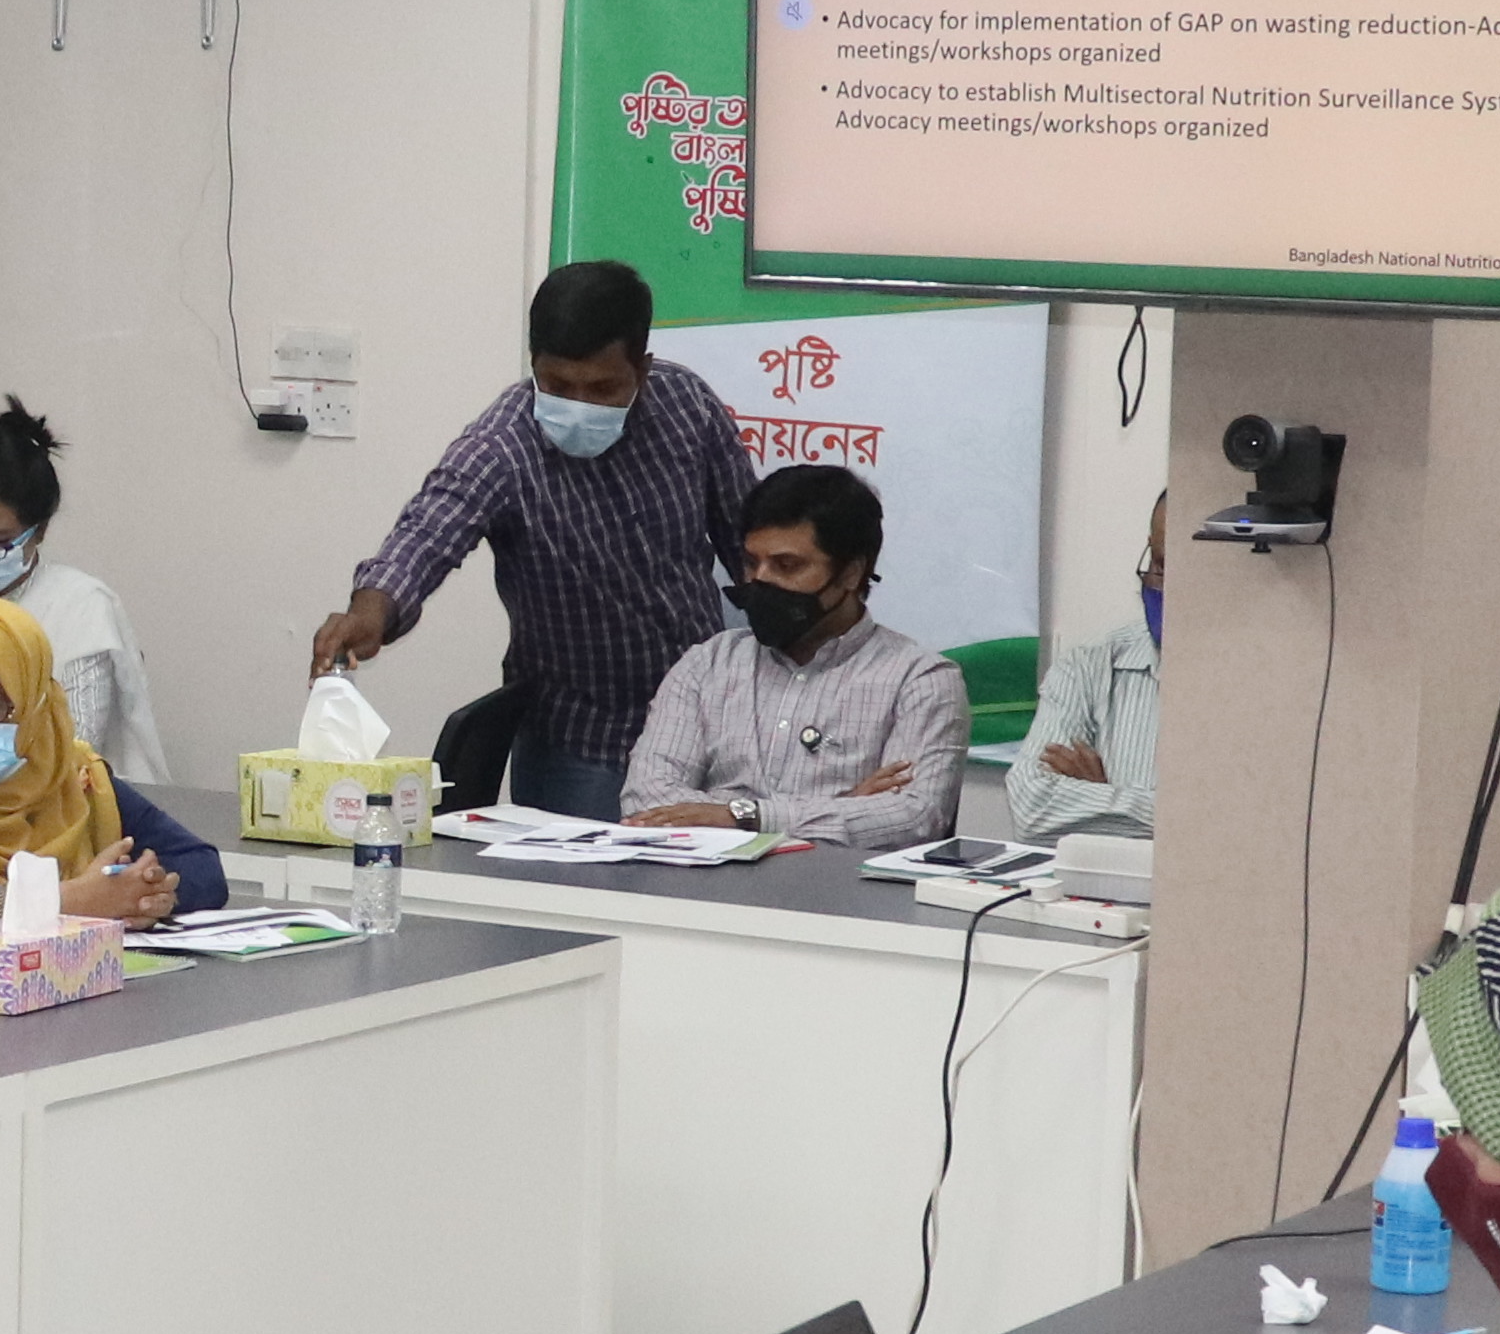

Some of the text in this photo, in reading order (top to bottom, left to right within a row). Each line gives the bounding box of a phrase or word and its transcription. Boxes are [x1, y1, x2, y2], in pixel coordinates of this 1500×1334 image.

[836, 9, 934, 34] Advocacy
[938, 10, 969, 29] for
[975, 11, 1143, 34] implementation
[1149, 12, 1173, 31] of
[1177, 13, 1224, 32] GAP
[1230, 18, 1258, 32] on
[1265, 14, 1351, 39] wasting
[837, 39, 1161, 66] meetings/workshops organized
[623, 74, 710, 136] পুষ্টির
[835, 79, 933, 104] Advocacy
[937, 84, 959, 100] to
[965, 82, 1056, 102] establish
[1064, 83, 1204, 105] Multisectoral
[1212, 87, 1311, 107] Nutrition
[1318, 88, 1455, 110] Surveillance
[835, 109, 1269, 140] Advocacy meetings/workshops organized
[1288, 248, 1374, 265] Bangladesh
[1378, 252, 1441, 266] National
[723, 405, 885, 468] ন্নয়নের
